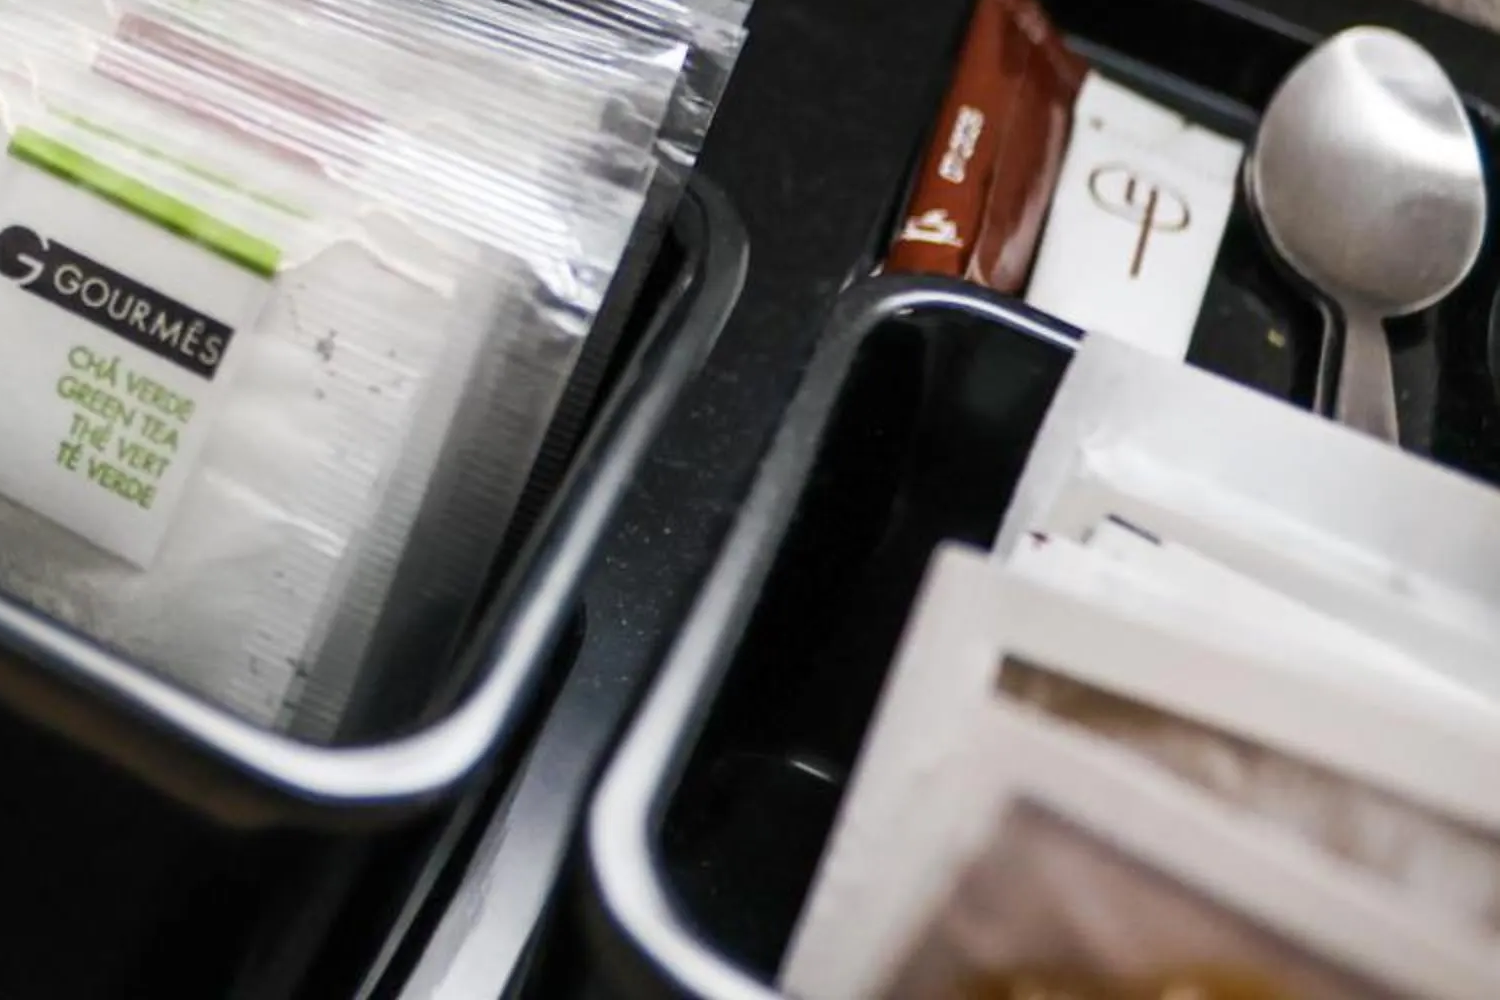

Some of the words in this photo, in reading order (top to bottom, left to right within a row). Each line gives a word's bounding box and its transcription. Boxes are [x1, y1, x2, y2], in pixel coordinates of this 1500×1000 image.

[53, 264, 222, 364] GOURMÊS
[56, 375, 135, 426] GREEN
[141, 413, 179, 452] TEA
[127, 372, 195, 423] VERDE
[88, 456, 157, 510] VERDE
[118, 437, 171, 479] VERT
